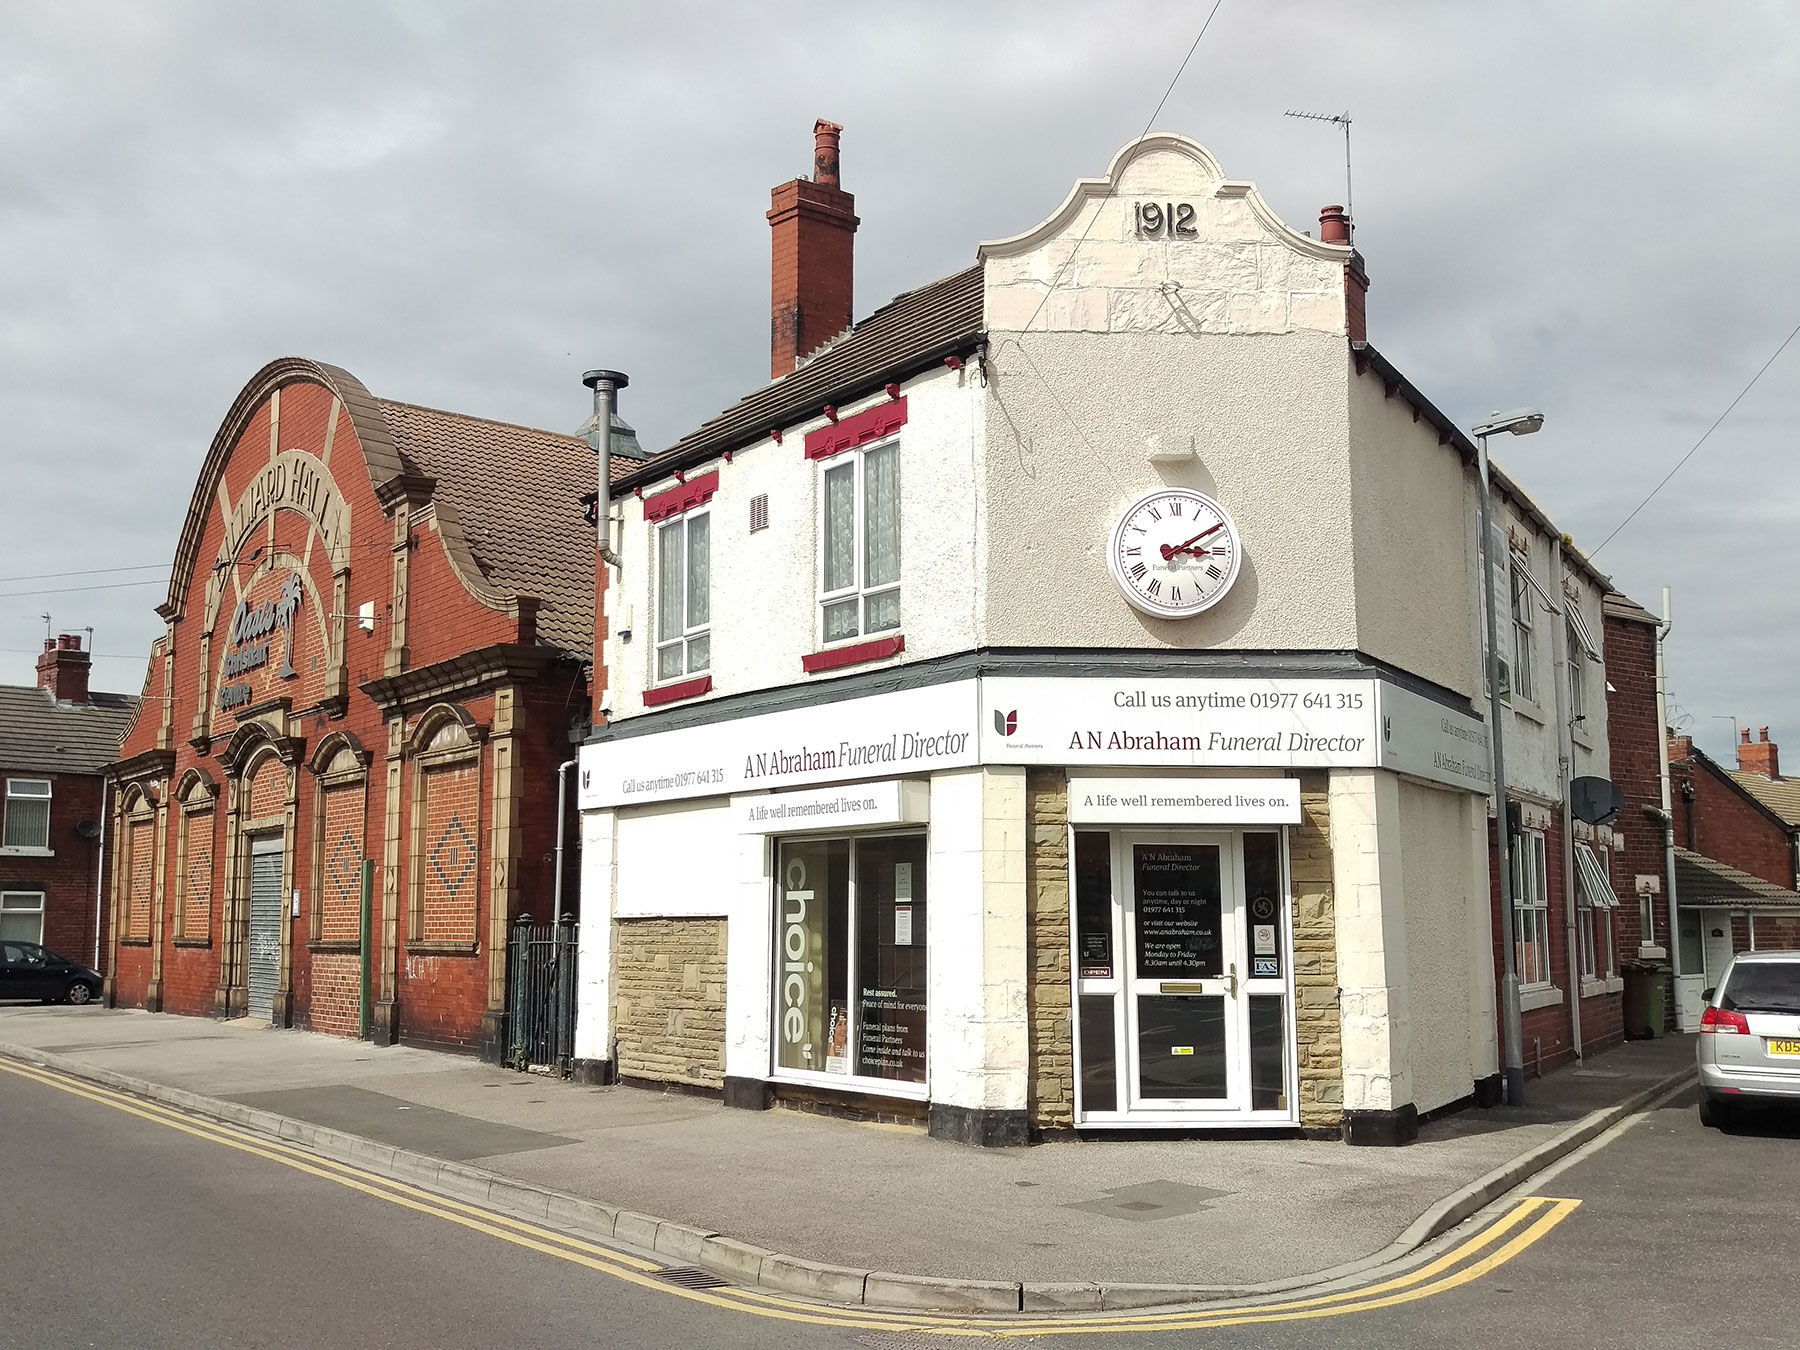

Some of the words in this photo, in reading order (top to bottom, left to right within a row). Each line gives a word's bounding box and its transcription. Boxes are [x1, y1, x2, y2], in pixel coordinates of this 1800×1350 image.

[1134, 201, 1197, 234] 1912
[290, 458, 331, 541] HALL
[1148, 507, 1162, 523] XI
[1169, 502, 1183, 517] XII
[1193, 509, 1201, 521] I
[1132, 524, 1147, 536] X
[1127, 546, 1141, 556] IX
[1212, 547, 1226, 556] III
[1130, 562, 1149, 582] VIII
[1205, 564, 1222, 580] IIII
[1147, 578, 1162, 596] VII
[1171, 586, 1182, 600] VI
[1194, 581, 1204, 595] V
[232, 597, 276, 645] Oasis
[224, 640, 268, 677] Christian
[217, 683, 252, 710] Centre
[1113, 691, 1147, 708] Call
[1151, 695, 1171, 708] us
[1175, 692, 1246, 711] anytime
[1250, 693, 1298, 709] 01977
[1303, 693, 1332, 709] 641
[1336, 693, 1363, 710] 315
[1068, 731, 1084, 750] A
[1087, 731, 1103, 750] N
[1107, 731, 1202, 751] Abraham
[1207, 732, 1282, 751] Funeral
[1287, 732, 1365, 752] Director
[744, 755, 755, 779] A
[756, 753, 767, 777] N
[769, 746, 837, 777] Abraham
[838, 734, 897, 768] Funeral
[901, 729, 970, 761] Director
[622, 779, 636, 793] Call
[636, 781, 645, 792] us
[645, 776, 674, 793] anytime
[674, 772, 696, 788] 01977
[696, 770, 710, 784] 641
[711, 768, 724, 783] 315
[1084, 795, 1094, 807] A
[1097, 794, 1118, 807] life
[1120, 795, 1148, 807] well
[1151, 795, 1232, 807] remembered
[1235, 795, 1265, 807] lives
[1268, 798, 1289, 807] on.
[749, 807, 755, 821] A
[756, 806, 769, 821] life
[770, 803, 787, 819] well
[787, 798, 839, 818] remembered
[841, 797, 862, 813] lives
[863, 798, 878, 810] on.
[1142, 853, 1148, 861] A
[1149, 853, 1155, 861] N
[1157, 853, 1192, 862] Abraham
[1142, 863, 1170, 871] Funeral
[1171, 863, 1200, 871] Director
[1143, 898, 1170, 906] anytime,
[1170, 898, 1182, 906] day
[1190, 898, 1207, 907] night
[1175, 906, 1185, 914] 315
[1143, 928, 1212, 936] www.anabraham.co.uk
[784, 857, 815, 1044] choice
[1144, 951, 1169, 959] Monday
[1176, 950, 1197, 959] Friday
[1144, 959, 1167, 967] 8.30am
[1168, 959, 1182, 967] until
[1183, 959, 1206, 968] 4.30pm
[1255, 962, 1277, 970] FAS
[863, 987, 875, 997] Rest
[875, 989, 898, 998] assured.
[862, 999, 877, 1008] Peace
[878, 999, 884, 1008] of
[883, 1001, 897, 1010] mind
[897, 1001, 905, 1010] for
[905, 1003, 927, 1013] everyon
[862, 1021, 881, 1031] Funeral
[881, 1023, 896, 1033] plans
[896, 1023, 909, 1033] from
[862, 1033, 881, 1042] Funeral
[881, 1034, 903, 1045] Partners
[862, 1044, 875, 1054] Come
[876, 1045, 891, 1055] inside
[891, 1047, 901, 1056] and
[901, 1048, 912, 1057] talk
[912, 1049, 918, 1057] to
[861, 1056, 904, 1068] choiceplan.co.uk
